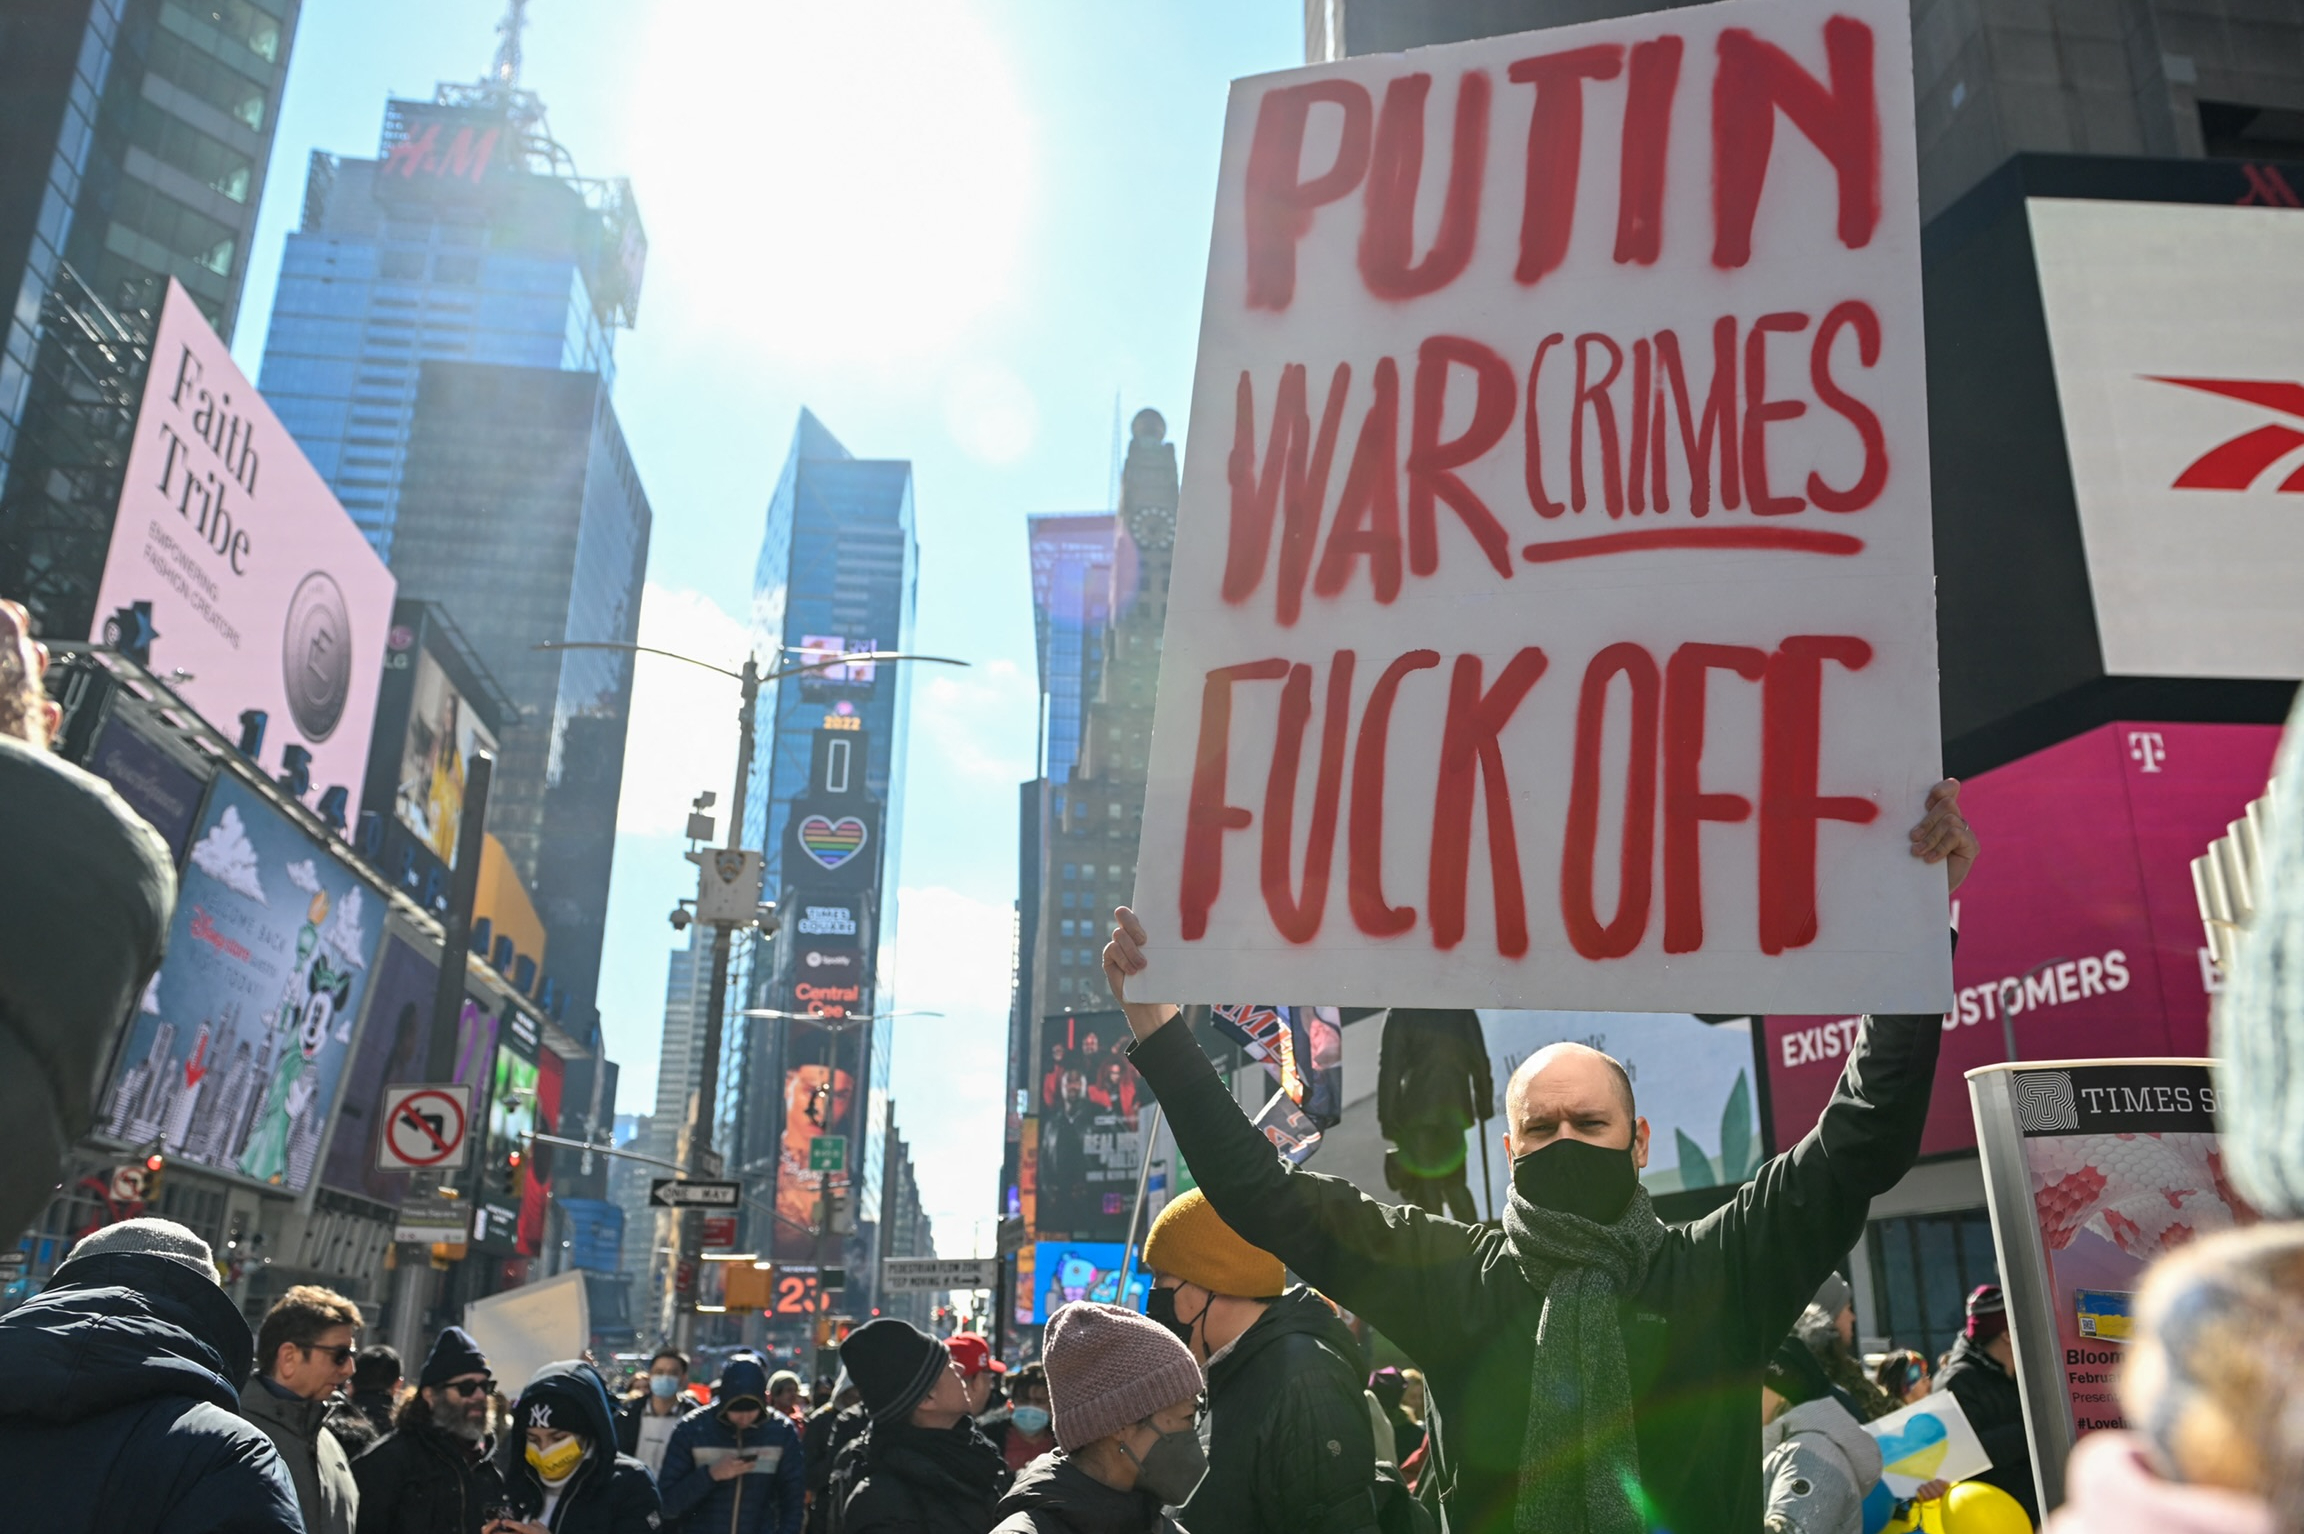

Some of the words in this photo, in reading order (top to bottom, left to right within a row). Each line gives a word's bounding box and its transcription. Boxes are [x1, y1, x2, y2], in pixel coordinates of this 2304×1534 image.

[1245, 13, 1884, 310] PUTIN
[168, 343, 260, 499] Faith
[1221, 334, 1518, 627] WAR
[1524, 300, 1889, 520] CRIMES
[156, 423, 251, 577] Tribe
[148, 519, 219, 603] EMPOWERING
[144, 543, 190, 600] FASHION
[190, 590, 241, 650] CREATORS
[824, 715, 861, 731] 2022
[1179, 645, 1548, 960] FUCK
[1560, 635, 1880, 962] OFF
[795, 982, 859, 1002] Central
[807, 1000, 844, 1018] Cee
[1942, 949, 2130, 1031] USTOMERS
[1781, 1017, 1860, 1068] EXIST
[2081, 1087, 2193, 1114] TIMES
[663, 1187, 688, 1199] ONE
[702, 1189, 730, 1200] WAY
[888, 1263, 937, 1274] PEDESTRIAN
[940, 1263, 960, 1273] FLOW
[961, 1263, 981, 1273] ZONE
[910, 1276, 940, 1287] MOVING
[2068, 1372, 2120, 1384] Februa
[528, 1404, 552, 1429] NY
